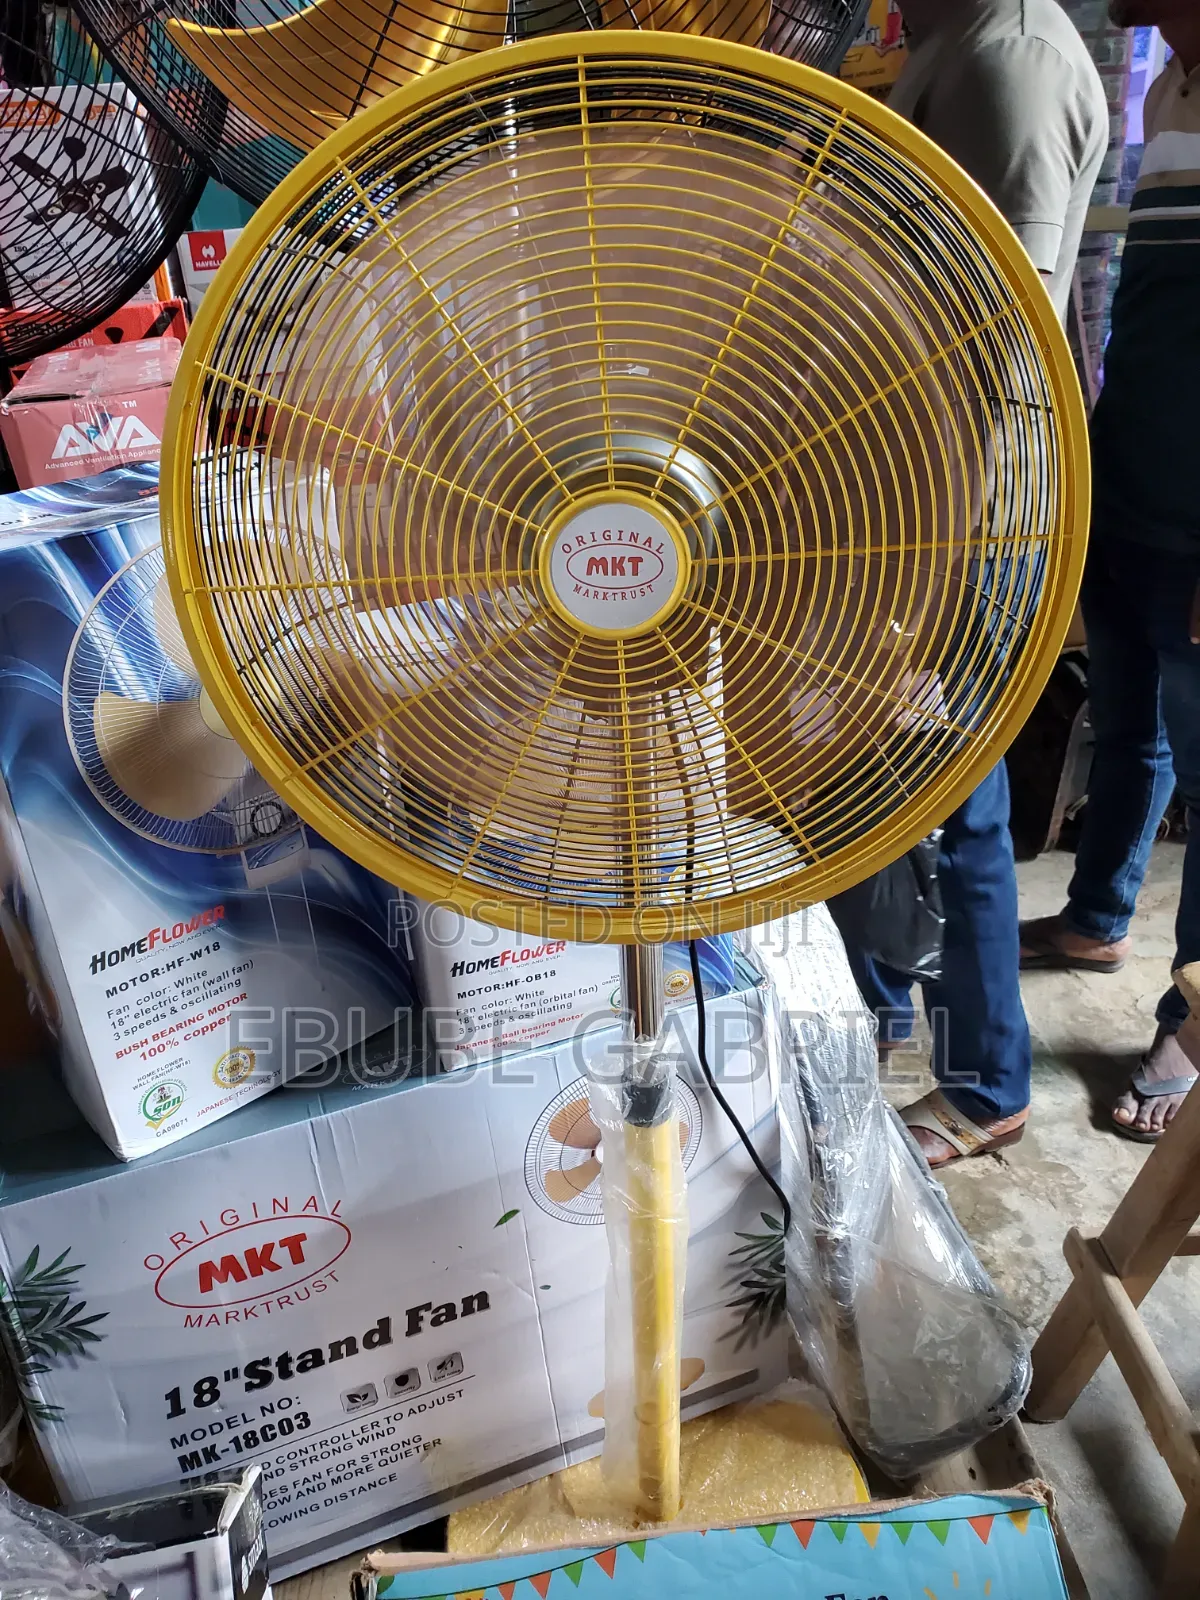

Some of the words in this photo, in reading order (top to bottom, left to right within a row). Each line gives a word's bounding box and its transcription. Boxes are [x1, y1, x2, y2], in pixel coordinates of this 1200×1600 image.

[195, 260, 224, 268] HAVELL
[122, 400, 137, 409] TM
[45, 460, 84, 470] Advanced
[561, 529, 666, 555] ORIGINAL
[586, 556, 644, 577] MKT
[572, 583, 655, 602] MARKTRUST
[169, 940, 185, 950] NOW
[186, 932, 201, 942] AND
[105, 941, 221, 999] MOTOR:HF-W18
[134, 995, 179, 1020] electric
[181, 986, 200, 998] fan
[202, 970, 230, 991] (wall
[231, 961, 255, 977] fan)
[457, 969, 557, 1000] MOTOR:HF-OB18
[602, 978, 620, 986] ORBITA
[106, 1004, 130, 1019] Fan
[136, 985, 172, 1006] color:
[173, 969, 208, 989] White
[114, 1031, 121, 1041] 3
[123, 1011, 167, 1036] speeds
[169, 1006, 178, 1016] &
[180, 978, 242, 1010] oscillating
[456, 1007, 476, 1016] Fan
[481, 998, 513, 1010] color:
[515, 989, 545, 1002] White
[478, 1006, 518, 1021] electric
[520, 1000, 536, 1012] fan
[539, 990, 576, 1007] (orbital
[578, 984, 598, 996] fan)
[115, 1038, 149, 1060] BUSH
[151, 1013, 205, 1042] BEARING
[207, 992, 248, 1016] MOTOR
[139, 1037, 180, 1061] 100%
[183, 1013, 232, 1041] copper
[454, 1035, 500, 1051] Japanese
[521, 1020, 556, 1035] bearing
[558, 1013, 584, 1025] Motor
[459, 1027, 465, 1035] 3
[467, 1018, 505, 1033] speeds
[518, 1001, 573, 1020] oscillating
[518, 1029, 551, 1042] copper
[132, 1079, 150, 1091] WALL
[137, 1071, 156, 1083] HOME
[157, 1057, 183, 1072] FLOWER
[196, 1094, 234, 1118] JAPANESE
[235, 1069, 282, 1098] TECHNOLOGY
[155, 1117, 189, 1138] CA09071
[143, 1195, 342, 1272] ORIGINAL
[198, 1232, 308, 1294] MKT
[183, 1269, 340, 1330] MARKTRUST
[404, 1289, 491, 1338] Fan
[169, 1412, 255, 1450] MODEL
[259, 1396, 302, 1417] NO:
[177, 1411, 311, 1474] MK-18C03
[275, 1421, 380, 1465] CONTROLLER
[383, 1412, 404, 1425] TO
[407, 1389, 465, 1417] ADJUST
[289, 1443, 354, 1472] STRONG
[356, 1426, 396, 1446] WIND
[292, 1471, 323, 1490] FAN
[326, 1459, 358, 1477] FOR
[360, 1434, 423, 1463] STRONG
[295, 1482, 327, 1500] AND
[330, 1464, 375, 1487] MORE
[378, 1438, 443, 1467] QUIETER
[262, 1503, 320, 1532] OWING
[324, 1472, 399, 1507] DISTANCE
